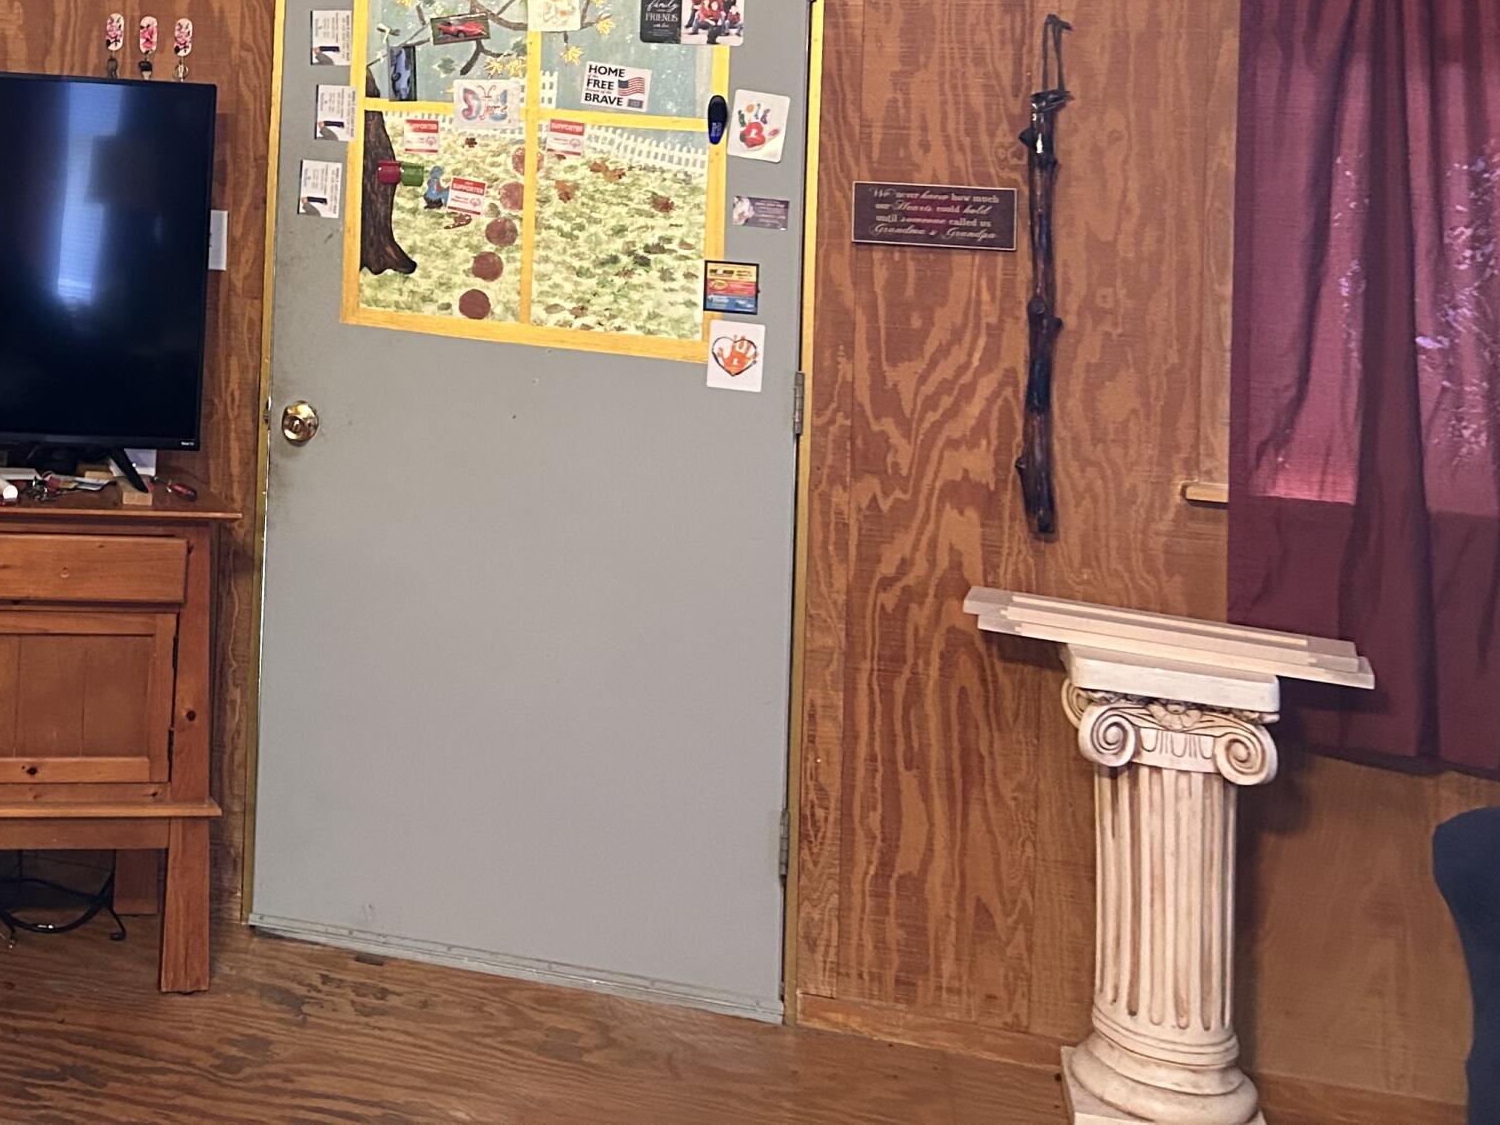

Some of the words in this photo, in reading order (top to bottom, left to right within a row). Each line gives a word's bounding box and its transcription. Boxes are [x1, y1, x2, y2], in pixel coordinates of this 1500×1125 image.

[645, 13, 678, 22] FRIENDS
[588, 64, 626, 78] HOME
[586, 78, 615, 90] FREE
[584, 92, 624, 106] BRAVE
[551, 121, 583, 132] SUPPORTER
[453, 182, 484, 194] SUPPORTER
[951, 192, 970, 202] how
[972, 194, 999, 203] much
[936, 205, 960, 213] could
[963, 204, 993, 215] hold
[876, 213, 898, 223] until
[900, 216, 947, 225] someone
[948, 217, 978, 227] called
[980, 220, 992, 228] us
[869, 222, 926, 236] Grandma
[942, 226, 997, 242] Grandpa
